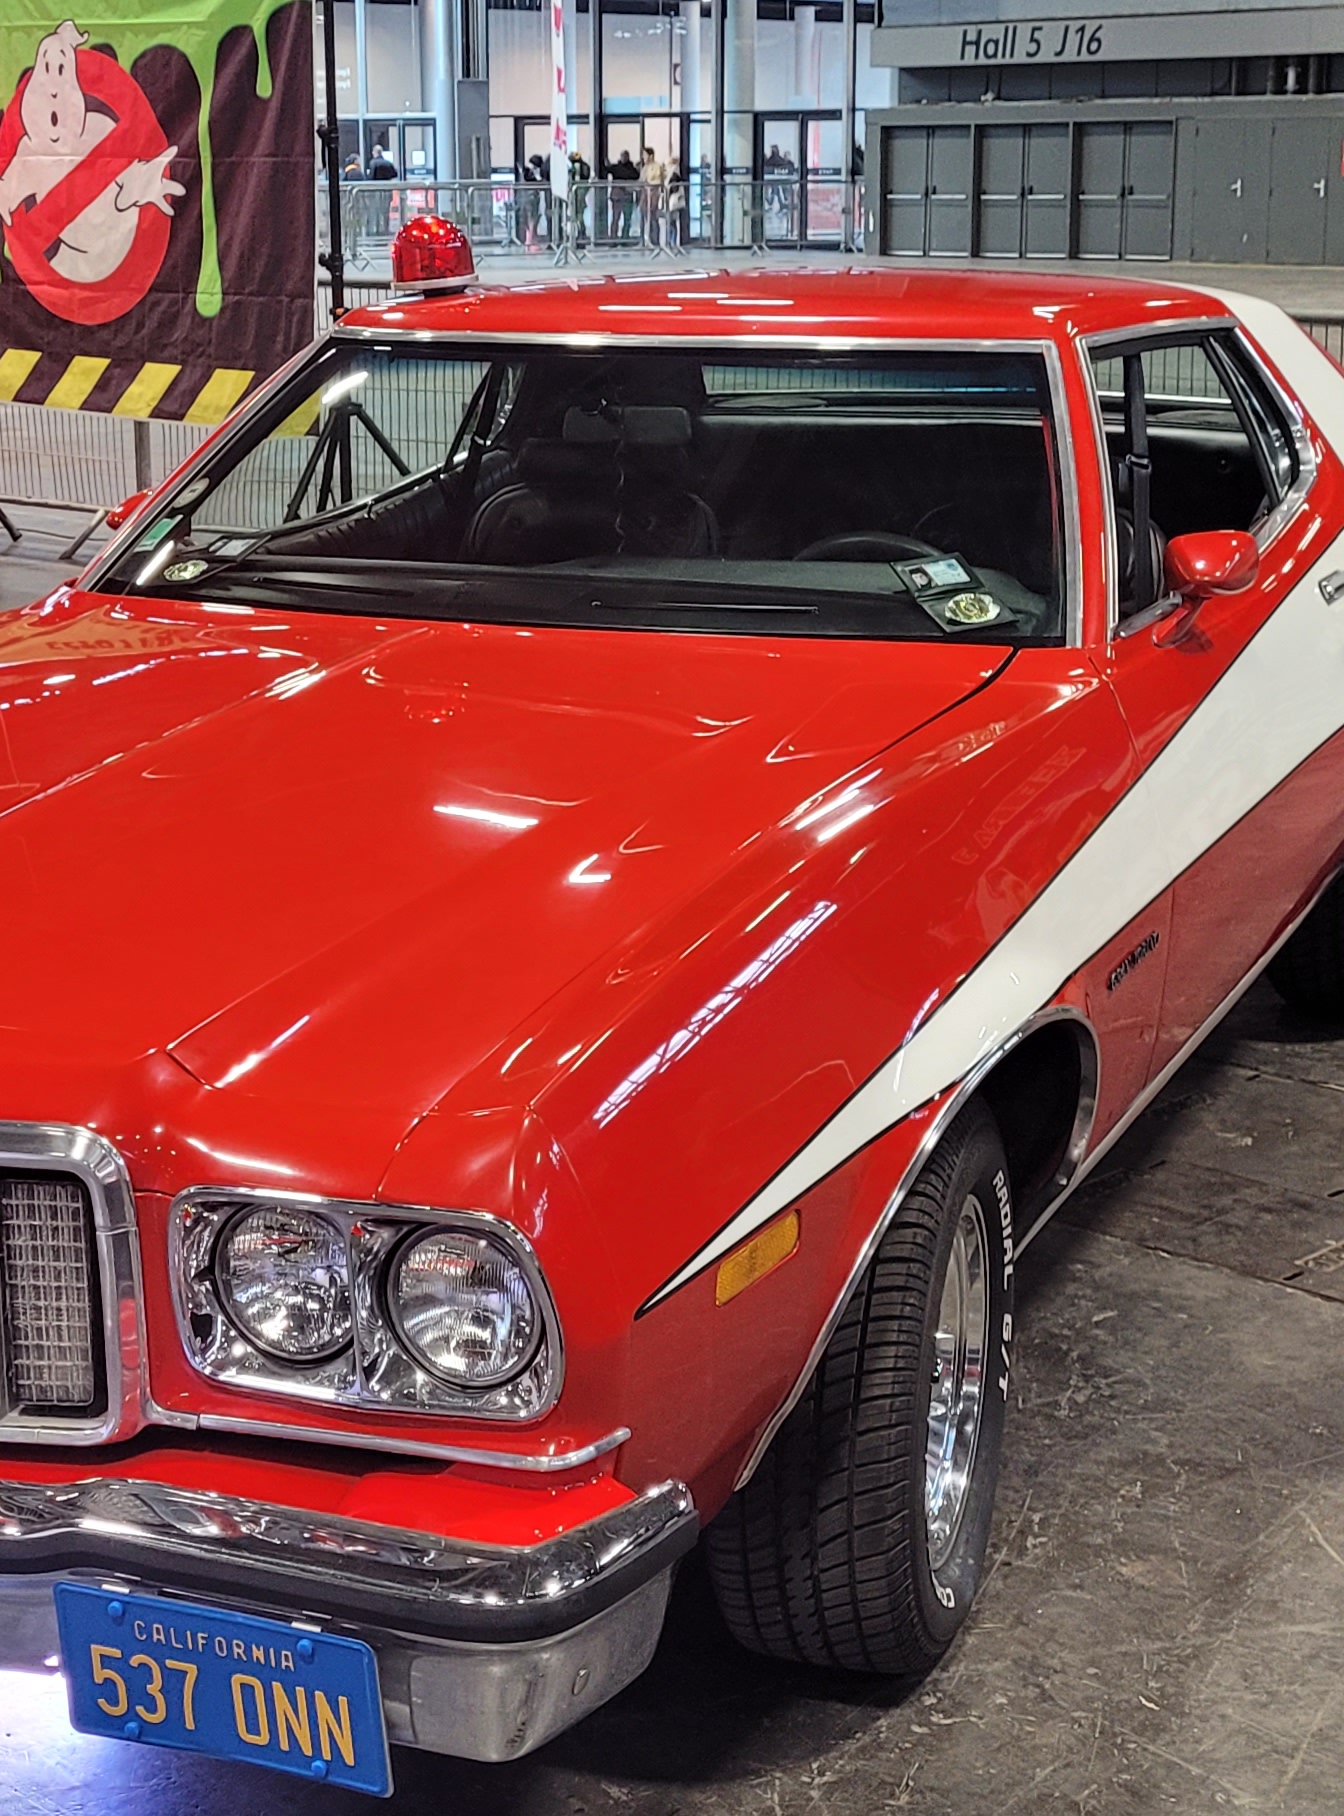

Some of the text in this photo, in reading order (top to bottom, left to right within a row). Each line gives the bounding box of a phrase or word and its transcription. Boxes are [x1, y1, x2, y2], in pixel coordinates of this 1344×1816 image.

[960, 24, 1103, 61] Hall 5 J16
[992, 1169, 1014, 1402] RADIAL G/T
[133, 1620, 295, 1672] CALIFORNIA
[90, 1643, 199, 1730] 537
